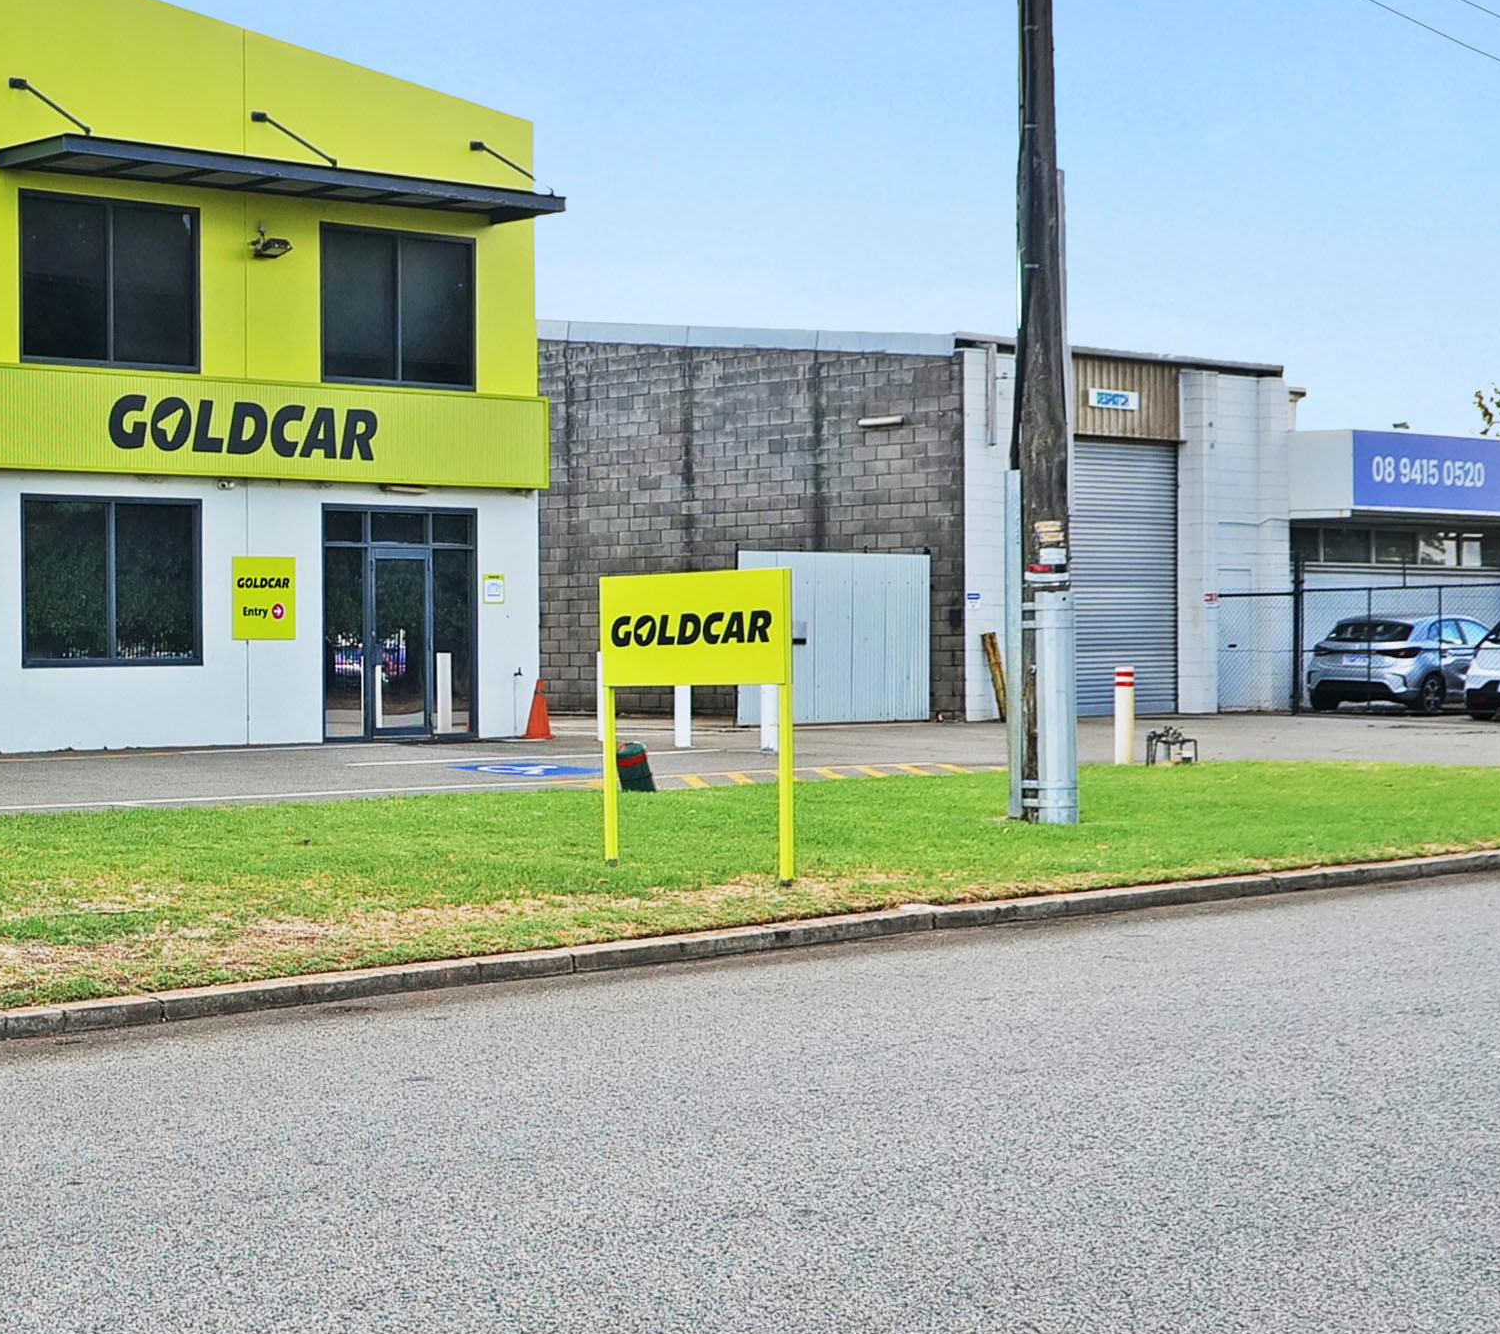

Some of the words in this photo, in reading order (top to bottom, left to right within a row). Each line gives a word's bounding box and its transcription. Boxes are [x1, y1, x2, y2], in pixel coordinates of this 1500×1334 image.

[108, 393, 378, 461] GOLDCAR
[1372, 455, 1396, 483] 08
[1399, 457, 1440, 485] 9415
[1442, 460, 1486, 487] 0520
[237, 577, 290, 589] GOLDCAR
[243, 606, 269, 619] Entry
[611, 610, 773, 648] GOLDCAR
